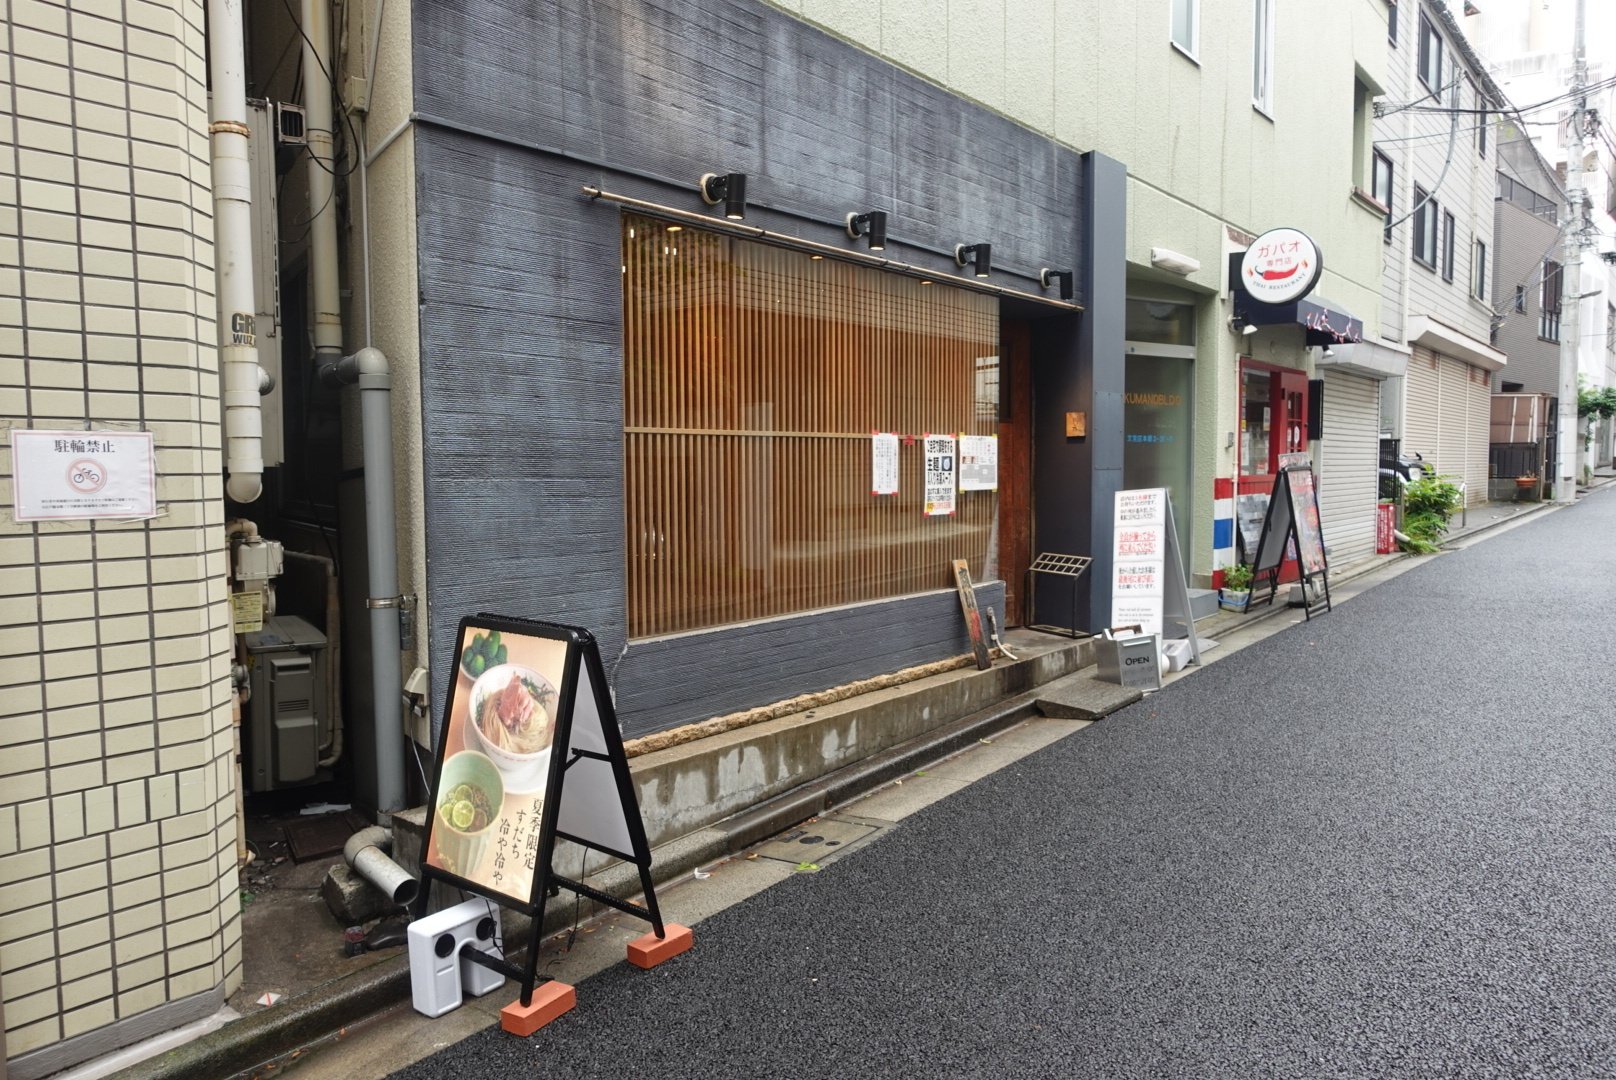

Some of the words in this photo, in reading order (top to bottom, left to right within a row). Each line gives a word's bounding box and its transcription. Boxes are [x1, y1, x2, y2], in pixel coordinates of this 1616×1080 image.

[1269, 272, 1306, 290] RESTAURANT
[54, 439, 116, 454] 駐輪禁止
[1125, 656, 1150, 666] OPEN
[511, 809, 527, 859] すだち
[522, 799, 544, 870] 夏季限定
[492, 818, 511, 886] 冷や冷や
